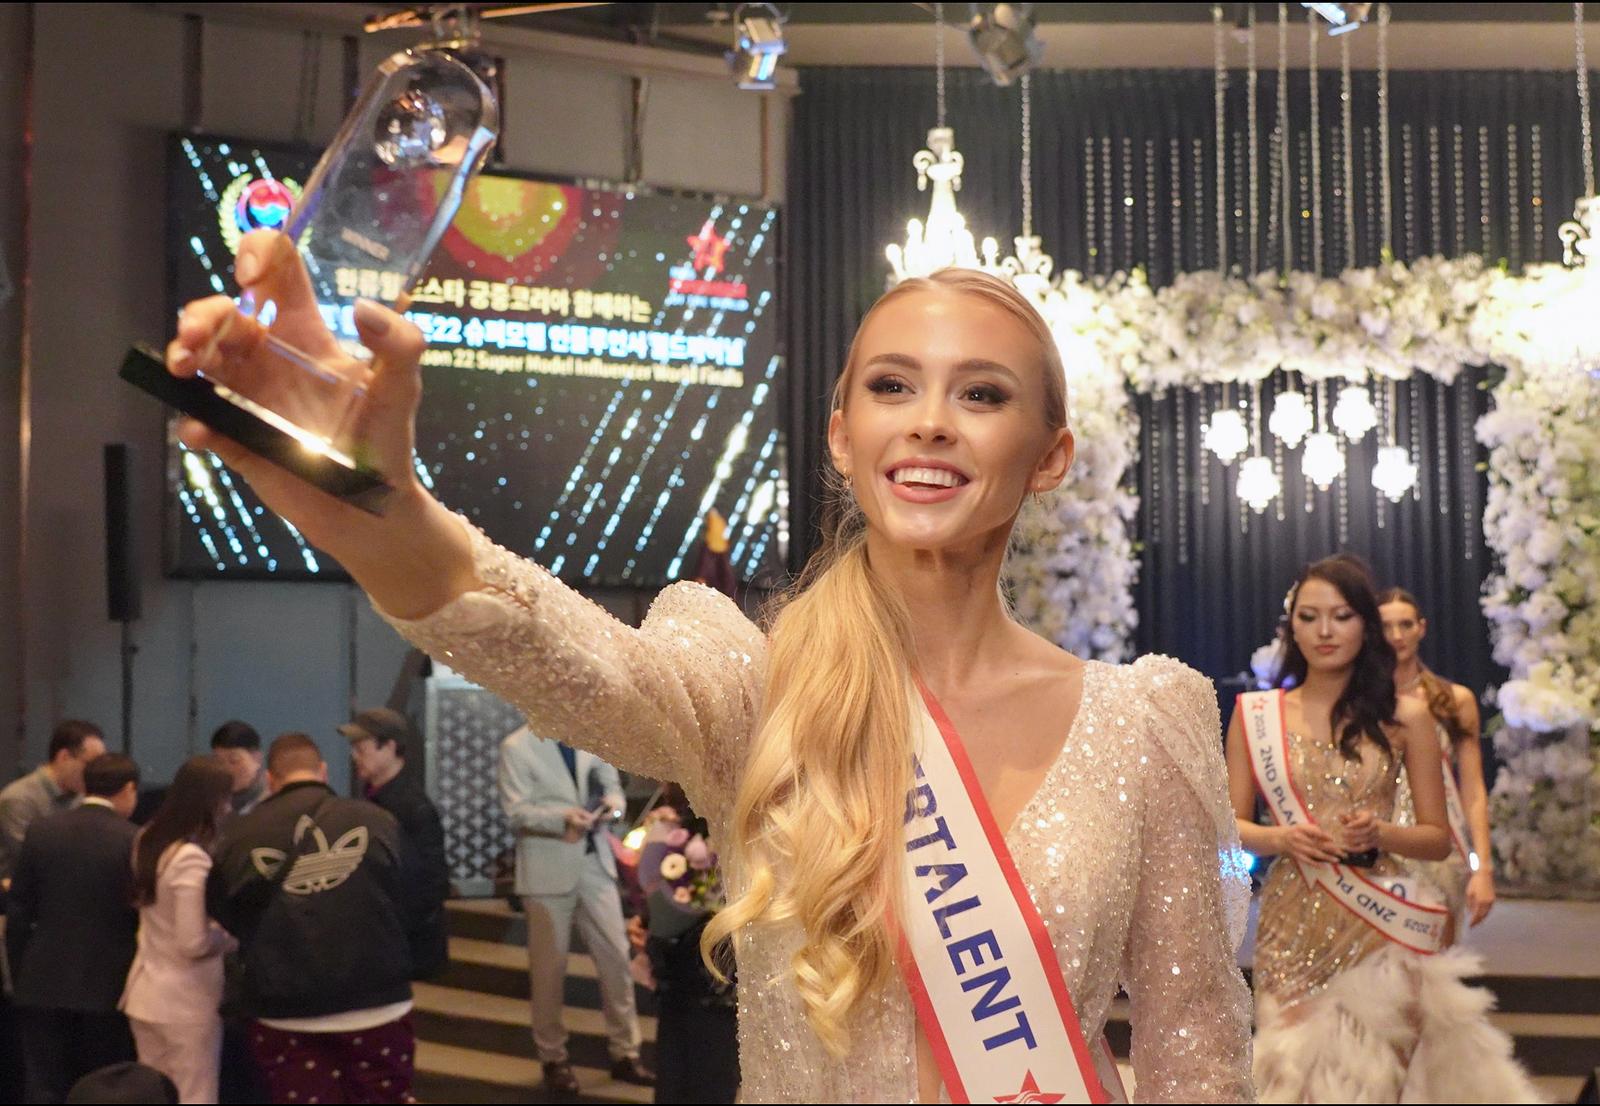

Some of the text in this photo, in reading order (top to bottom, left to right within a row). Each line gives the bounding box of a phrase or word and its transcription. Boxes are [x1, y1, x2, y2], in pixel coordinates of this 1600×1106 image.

[453, 348, 476, 369] 22
[476, 350, 525, 374] Super
[1260, 745, 1277, 782] 2ND
[1273, 786, 1298, 825] PLA
[904, 752, 1038, 1052] RTALENT
[1357, 893, 1397, 922] 2ND
